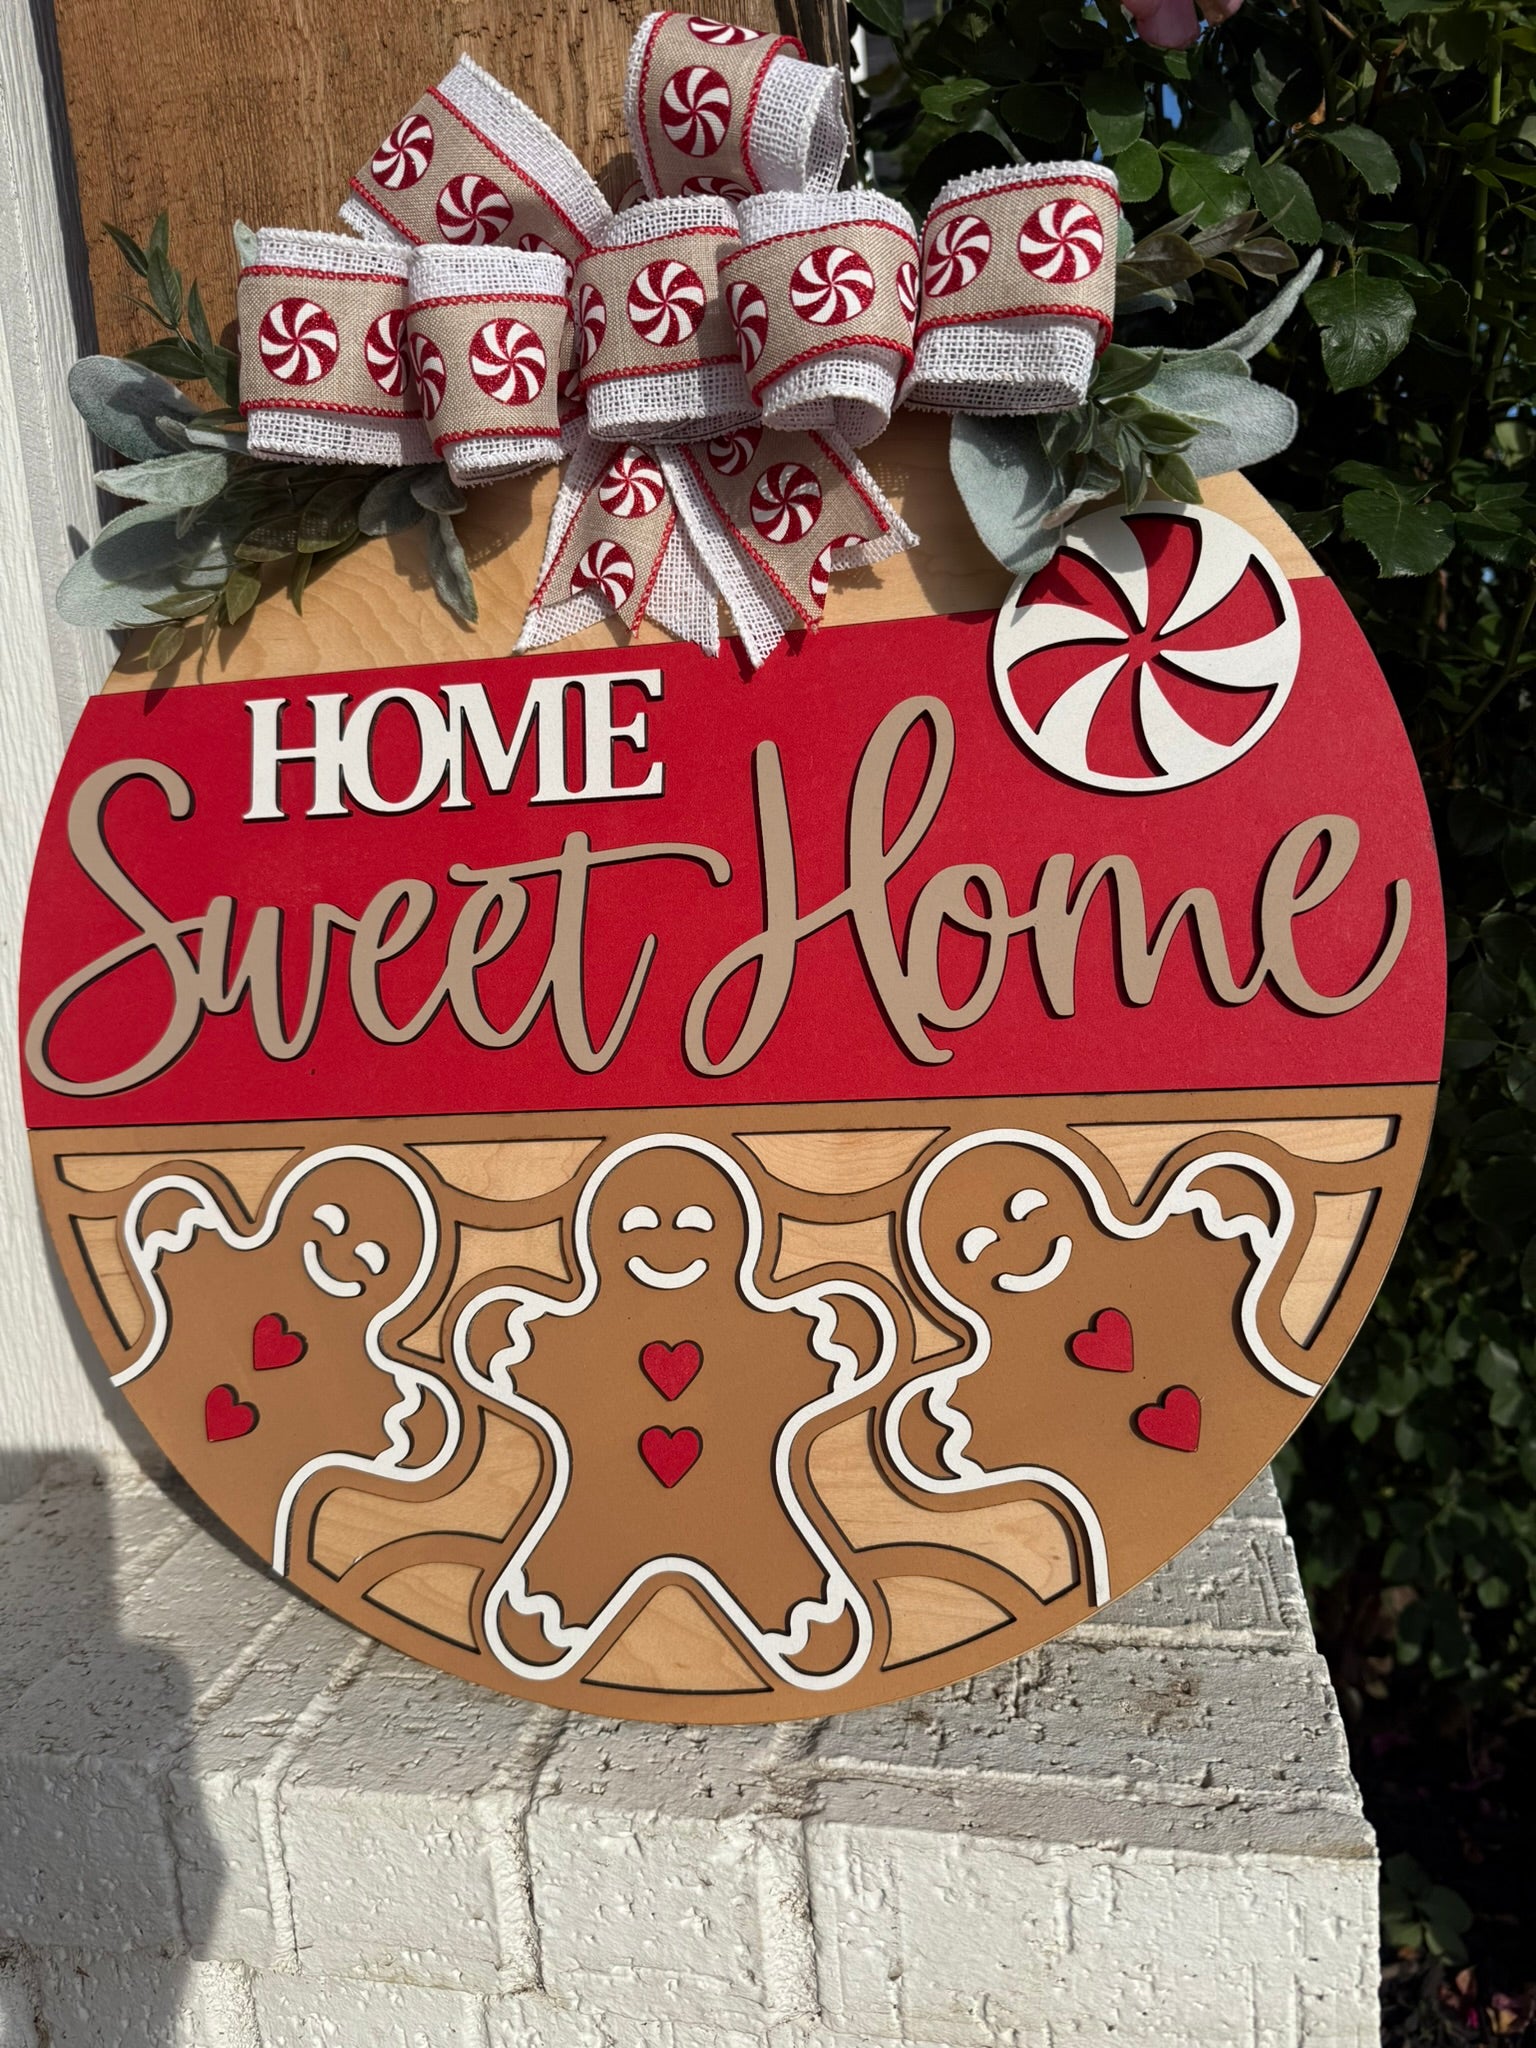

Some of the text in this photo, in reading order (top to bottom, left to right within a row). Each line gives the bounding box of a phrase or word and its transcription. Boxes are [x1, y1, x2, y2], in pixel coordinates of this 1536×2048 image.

[245, 669, 665, 821] HOME
[26, 696, 1412, 1096] Sweet Home
